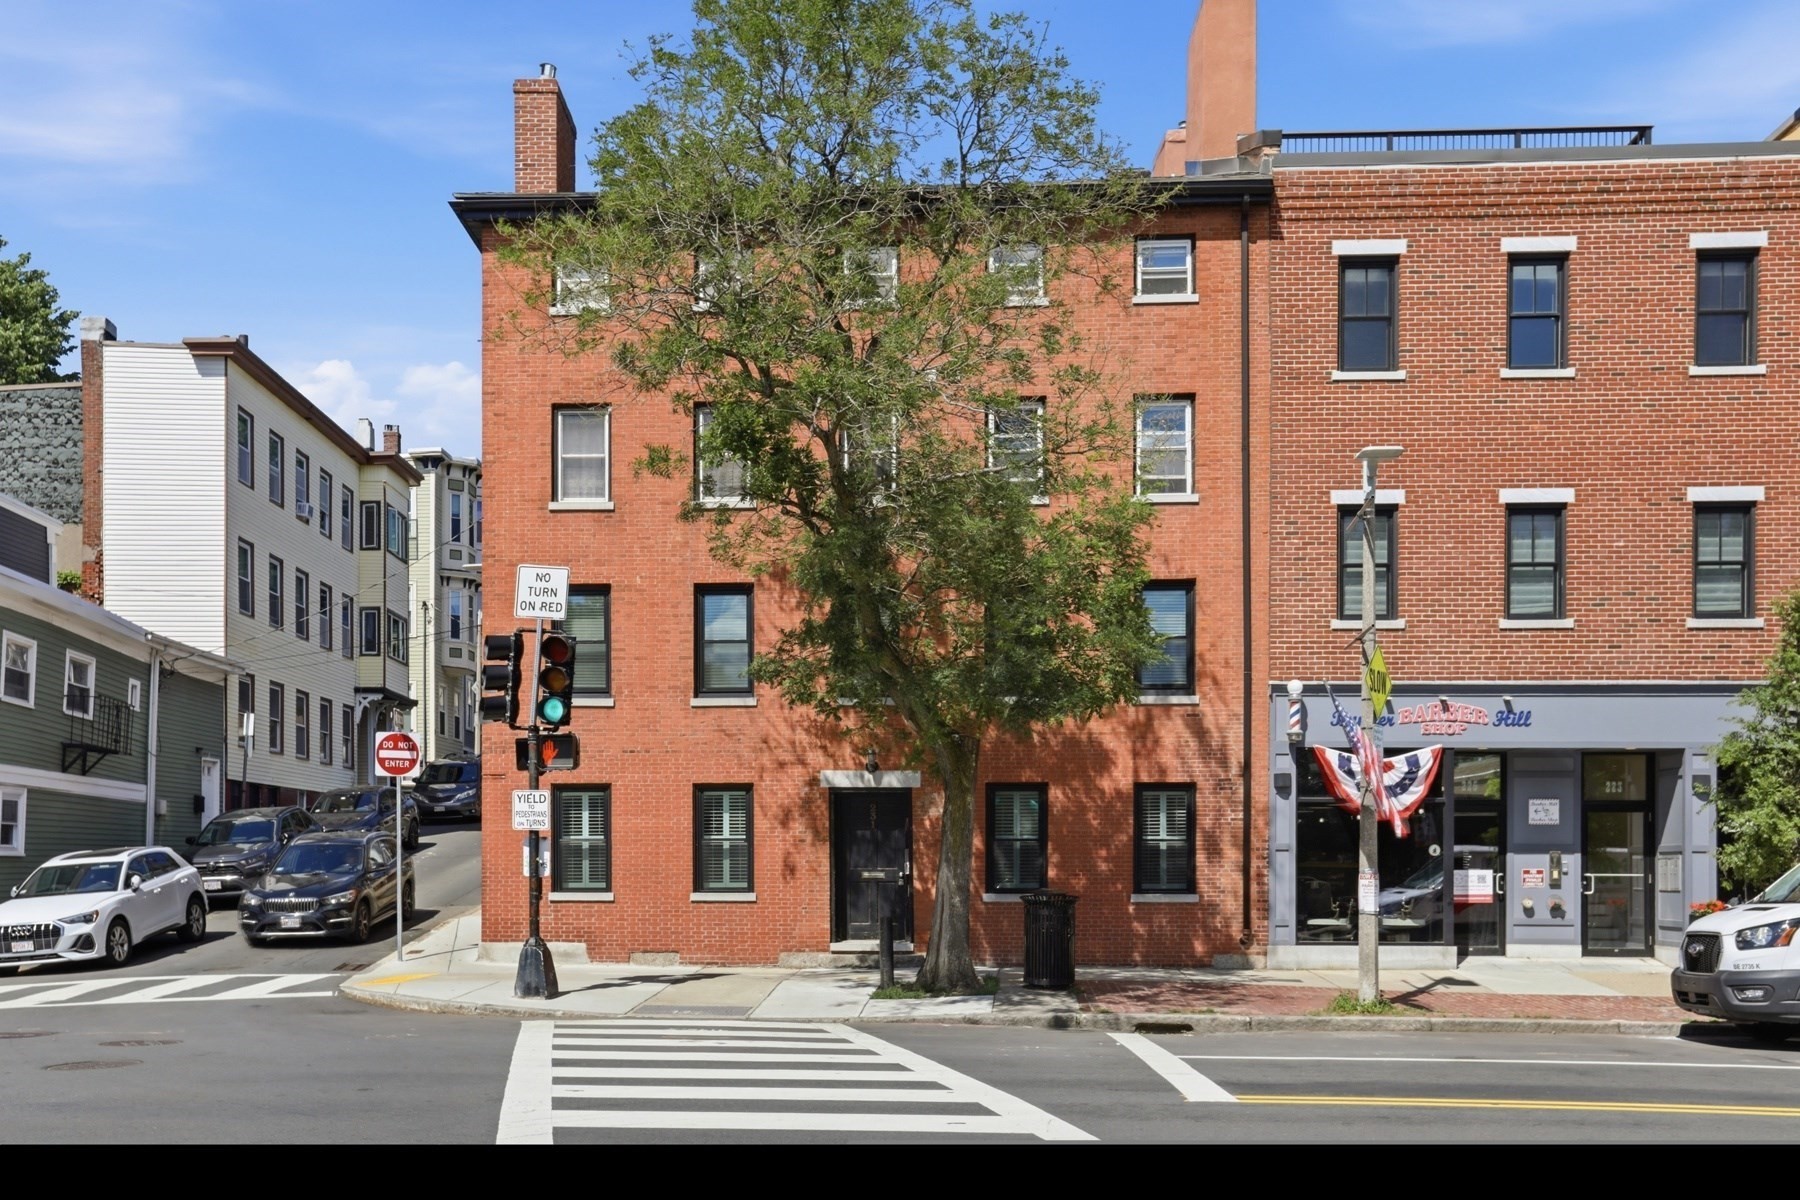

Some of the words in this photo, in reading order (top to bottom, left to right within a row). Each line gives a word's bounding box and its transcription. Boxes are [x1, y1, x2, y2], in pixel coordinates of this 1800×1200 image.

[535, 572, 551, 583] NO
[528, 586, 558, 598] TURN
[520, 600, 536, 611] ON
[540, 601, 563, 613] RED
[1369, 667, 1388, 695] SLOW
[1398, 702, 1488, 725] BARBER
[1492, 710, 1532, 727] Hill
[1421, 722, 1468, 736] SHOP
[398, 741, 414, 749] NOT
[385, 760, 409, 768] ENTER
[516, 793, 547, 804] YIELD
[515, 810, 548, 818] PEDESTRIANS
[526, 819, 547, 828] TURNS
